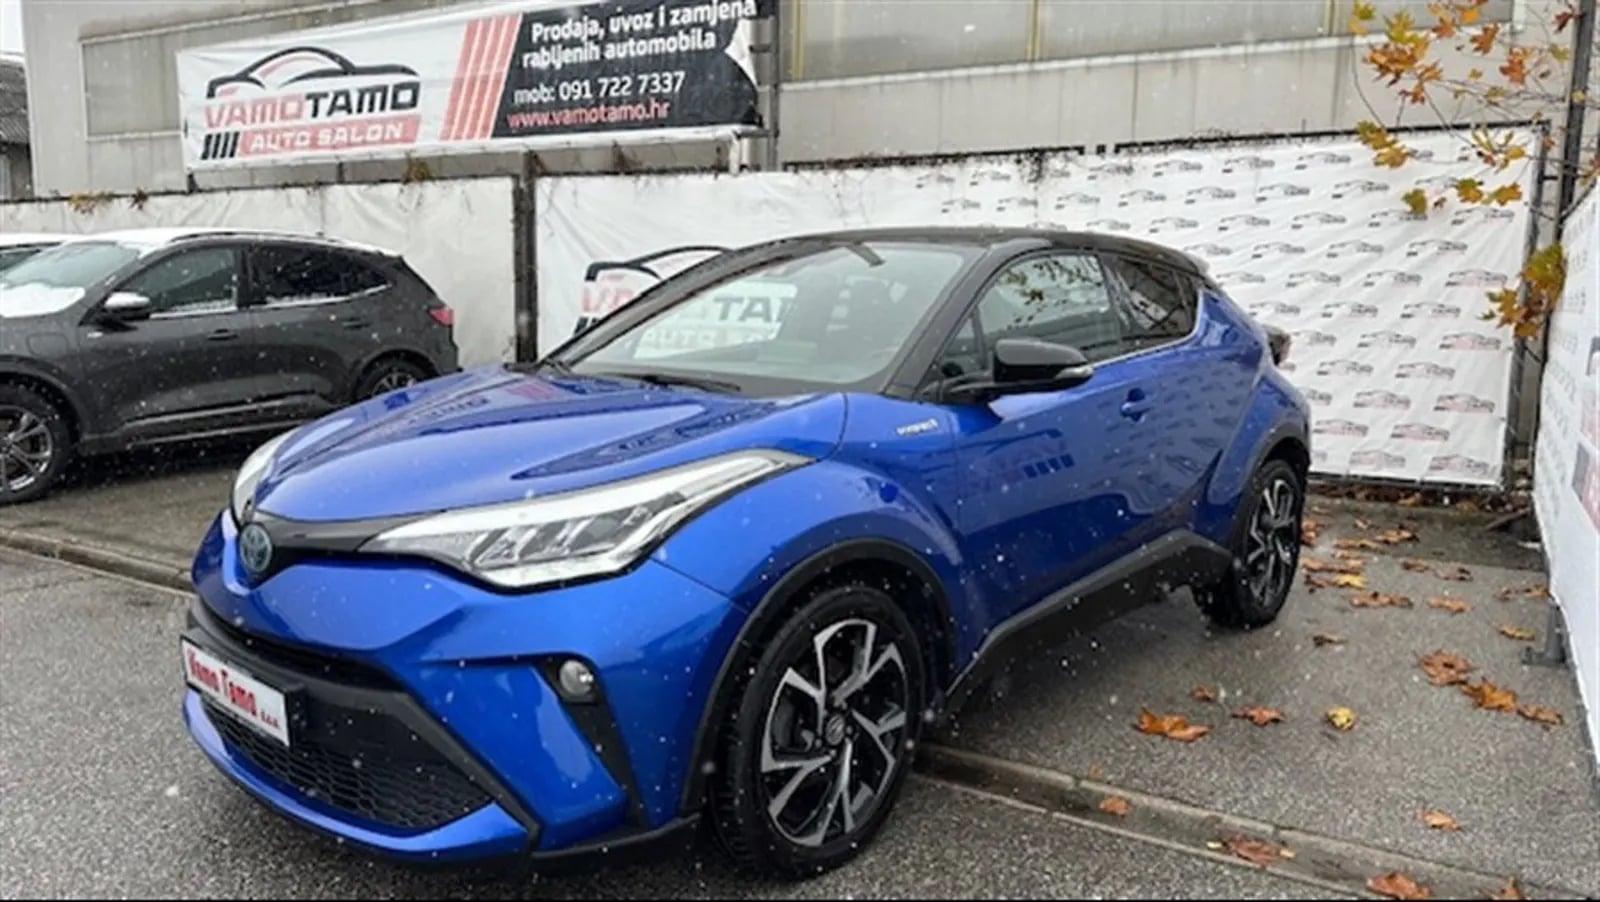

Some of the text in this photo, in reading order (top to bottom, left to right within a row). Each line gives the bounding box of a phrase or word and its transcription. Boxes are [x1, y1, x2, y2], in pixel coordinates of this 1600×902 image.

[531, 0, 757, 43] Prodaja, uvoz i zamjena
[522, 28, 716, 69] rabljenih automobila
[514, 71, 686, 105] mob: 091 722 7337
[507, 99, 670, 129] www.vamotamo.hr
[251, 123, 402, 151] AUTO SALON
